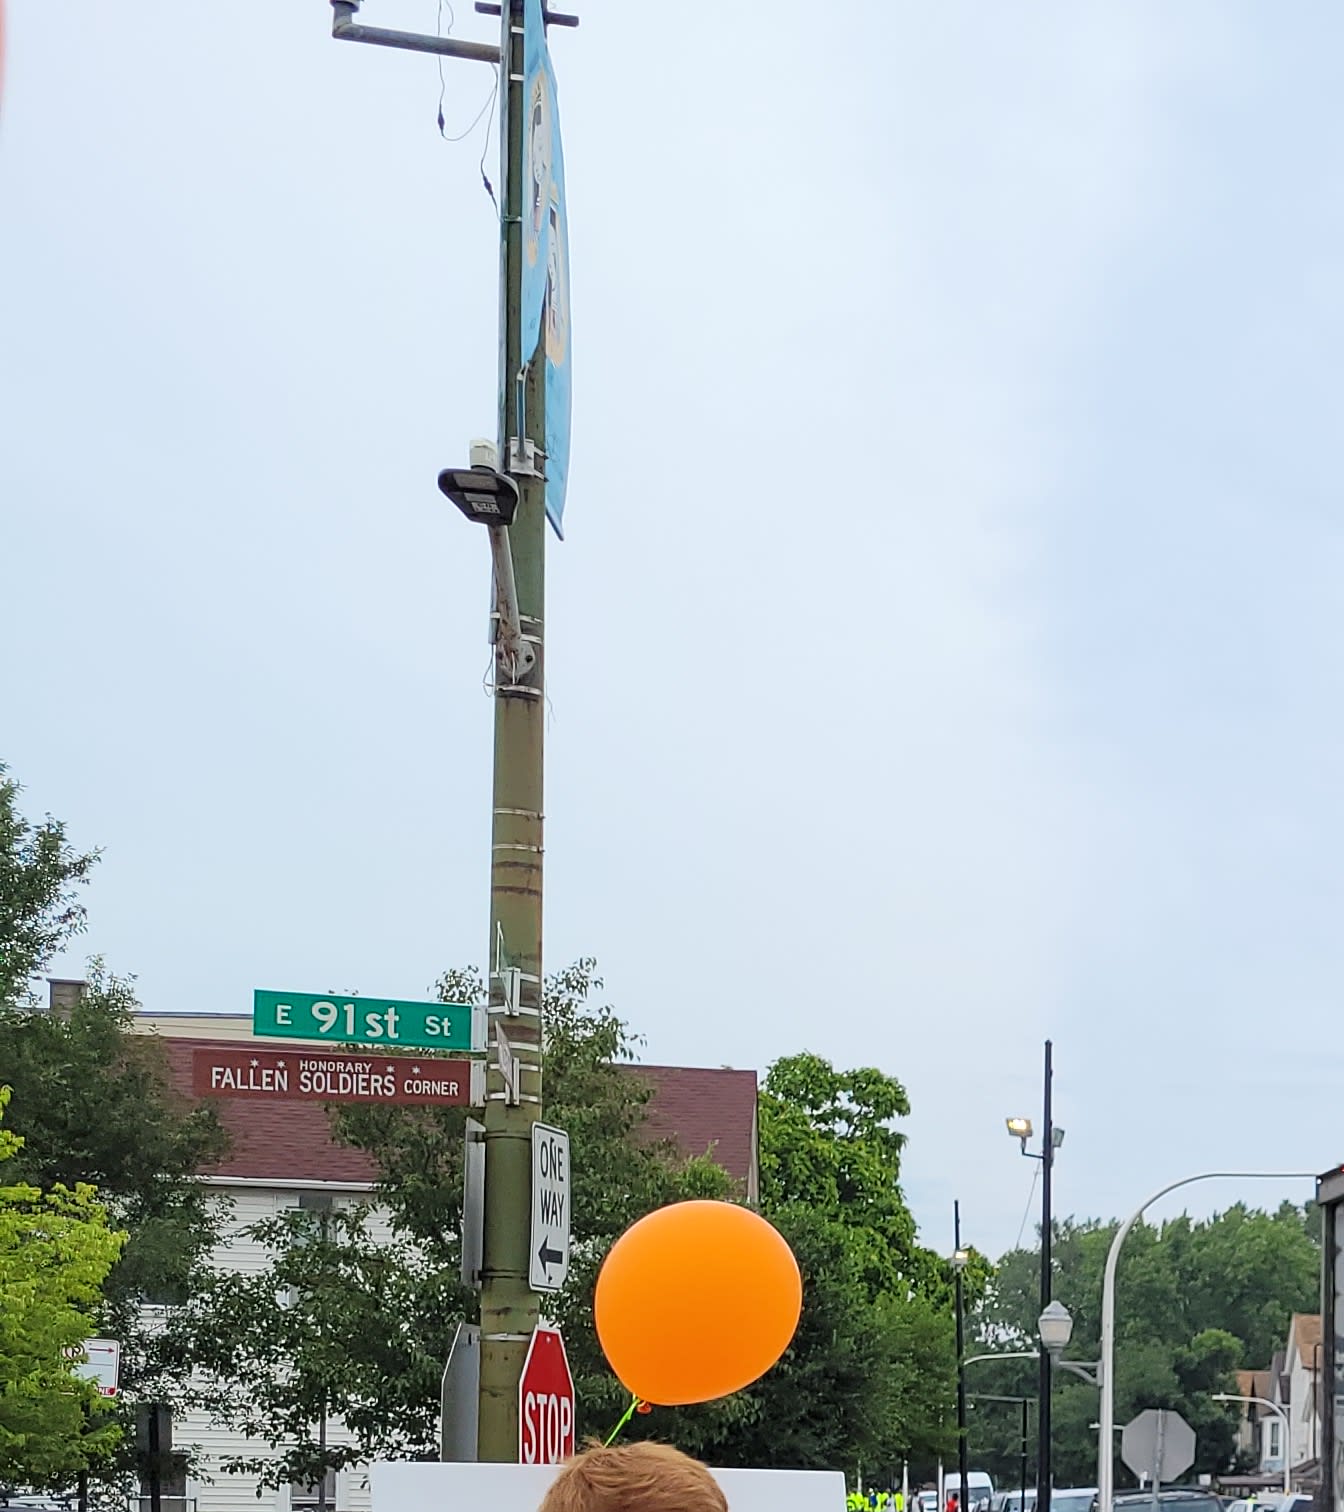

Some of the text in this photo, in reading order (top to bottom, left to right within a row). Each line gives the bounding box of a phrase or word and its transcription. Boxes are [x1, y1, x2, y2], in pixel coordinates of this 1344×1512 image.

[276, 1001, 451, 1039] E 91st St
[211, 1067, 459, 1096] FALLEN SOLDIERS CORNER
[300, 1060, 372, 1073] HONORARY
[540, 1140, 564, 1183] ONE
[540, 1188, 565, 1229] WAY
[524, 1395, 572, 1464] STOP
